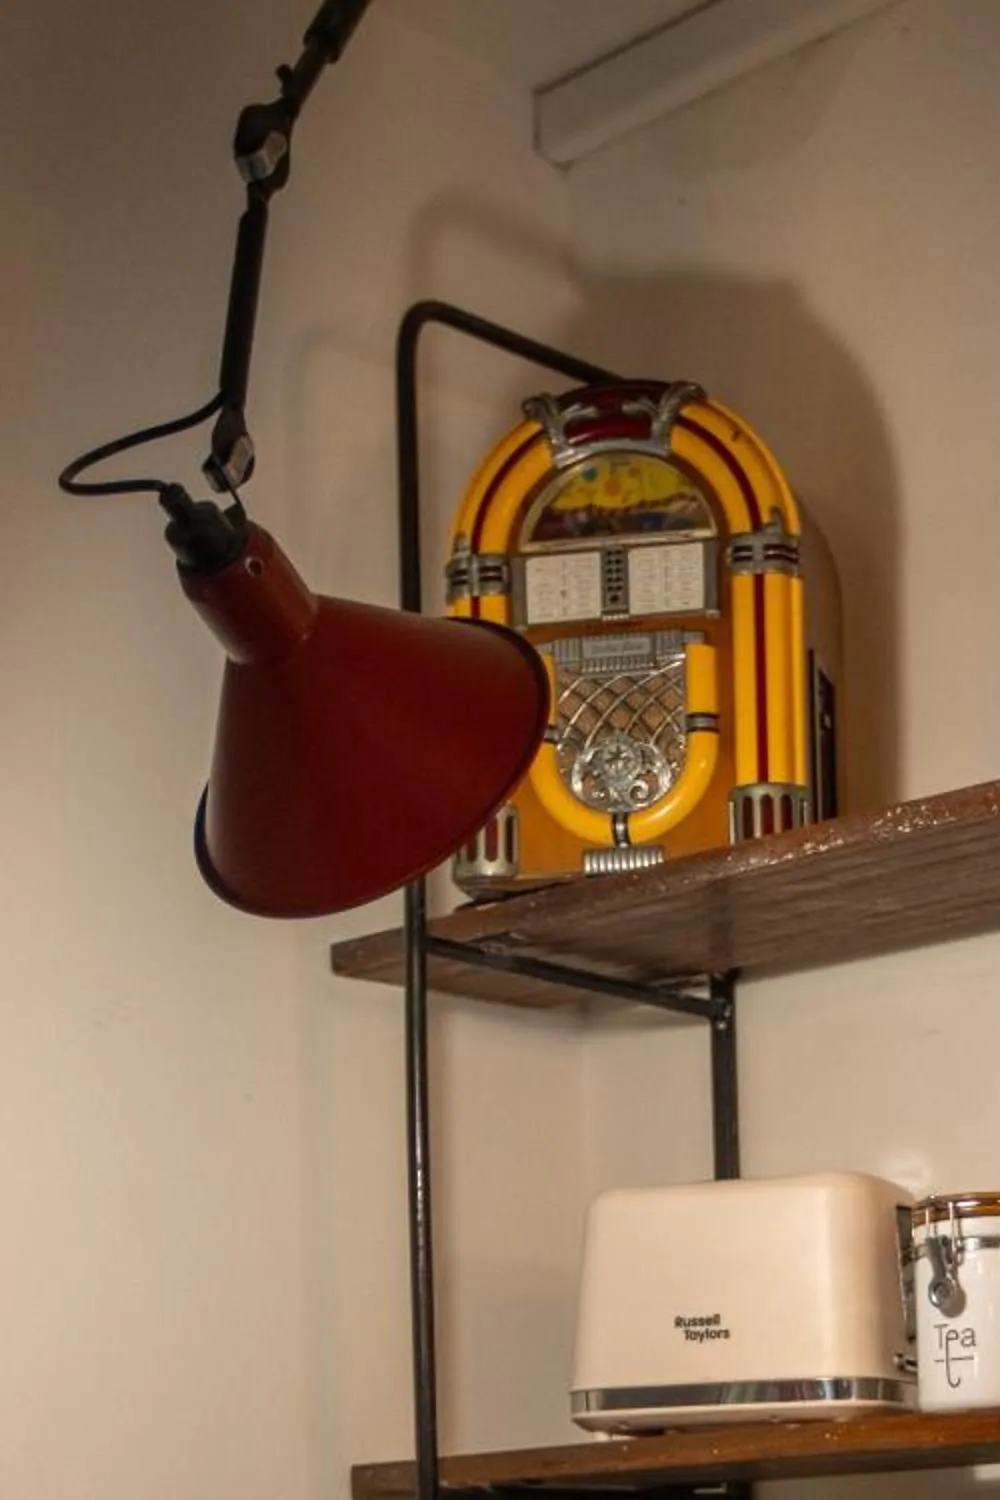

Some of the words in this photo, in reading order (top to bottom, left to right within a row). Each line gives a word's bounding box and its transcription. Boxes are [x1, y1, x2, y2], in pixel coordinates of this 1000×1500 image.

[674, 1313, 721, 1328] Russell
[683, 1328, 731, 1344] Taylors
[934, 1323, 977, 1389] Tea
